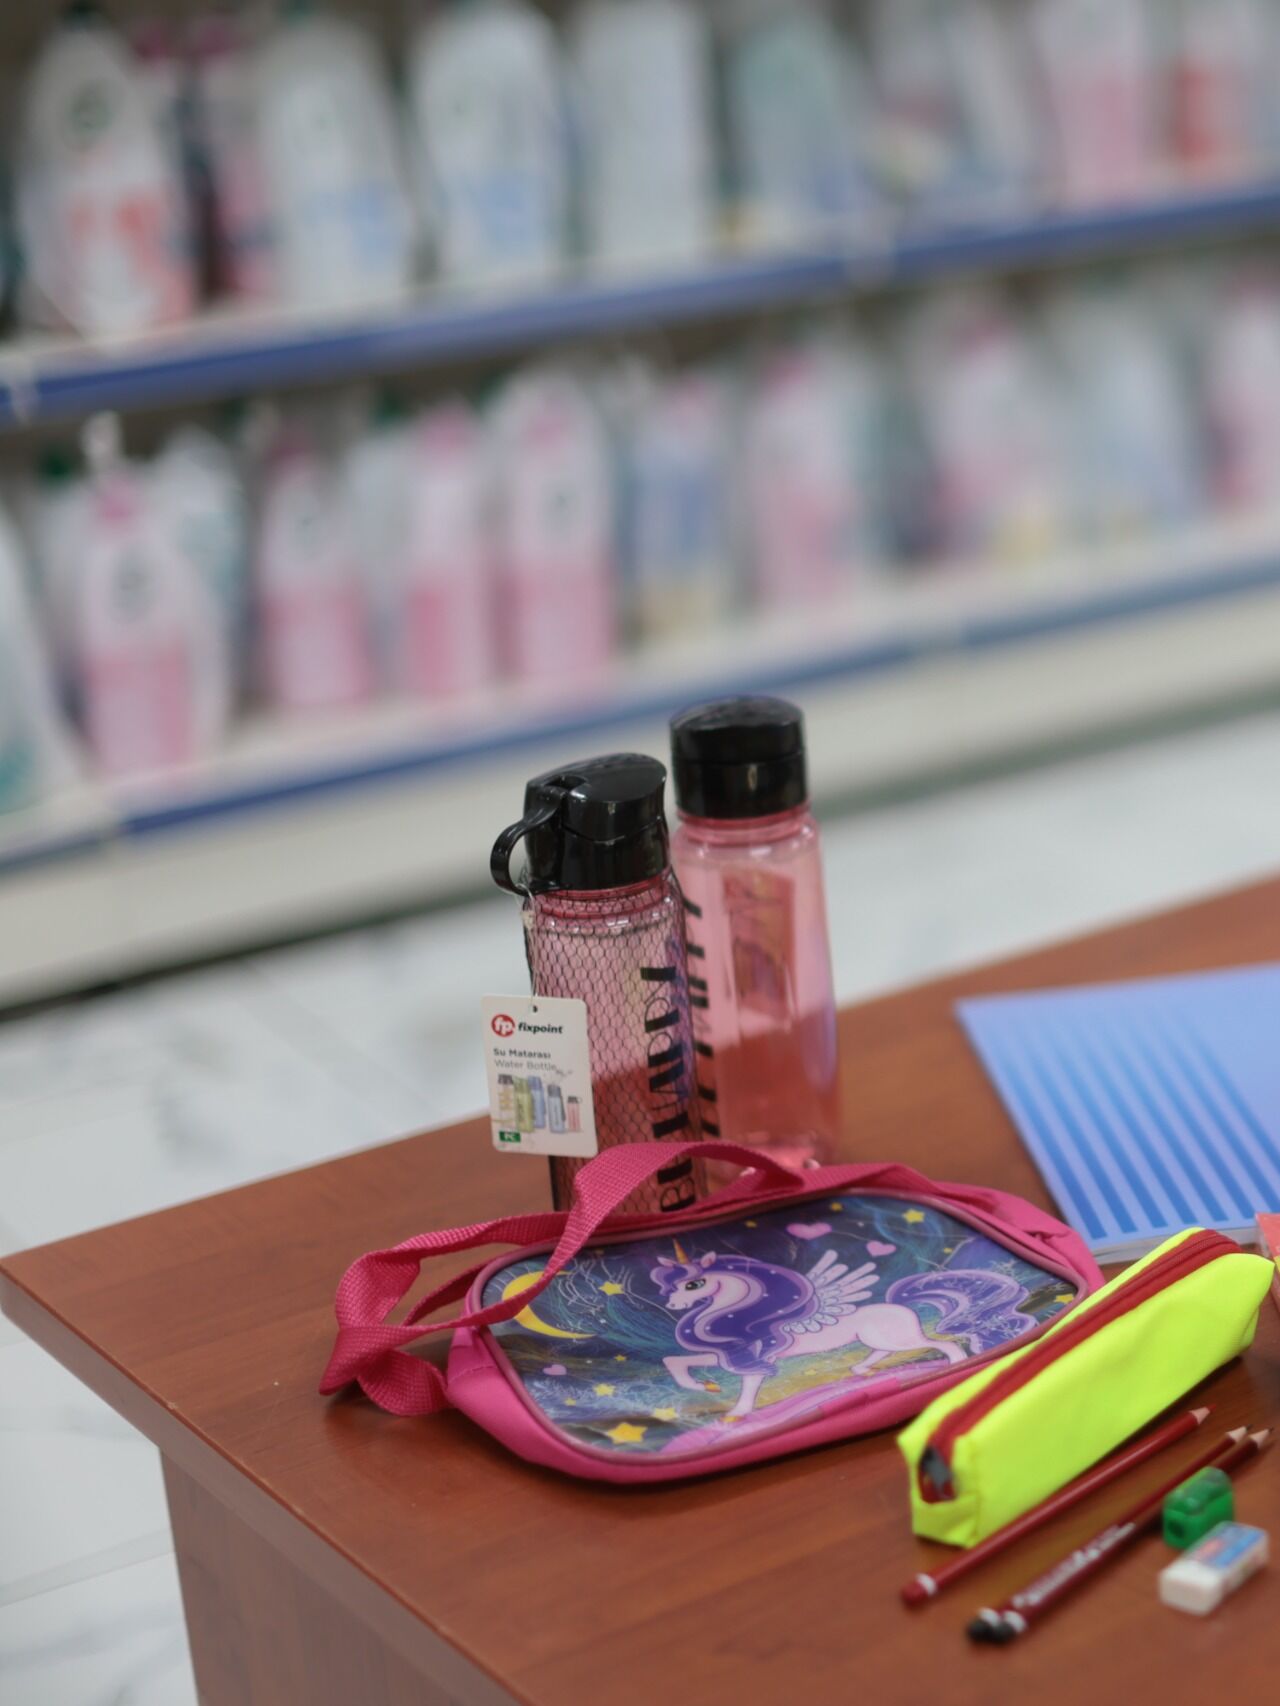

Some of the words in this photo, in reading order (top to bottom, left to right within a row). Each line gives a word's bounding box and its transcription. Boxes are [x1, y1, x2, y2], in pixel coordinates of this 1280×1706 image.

[518, 1022, 563, 1034] fixpoint
[494, 1048, 506, 1057] Su
[494, 1059, 524, 1069] Water
[527, 1061, 557, 1071] Bottle
